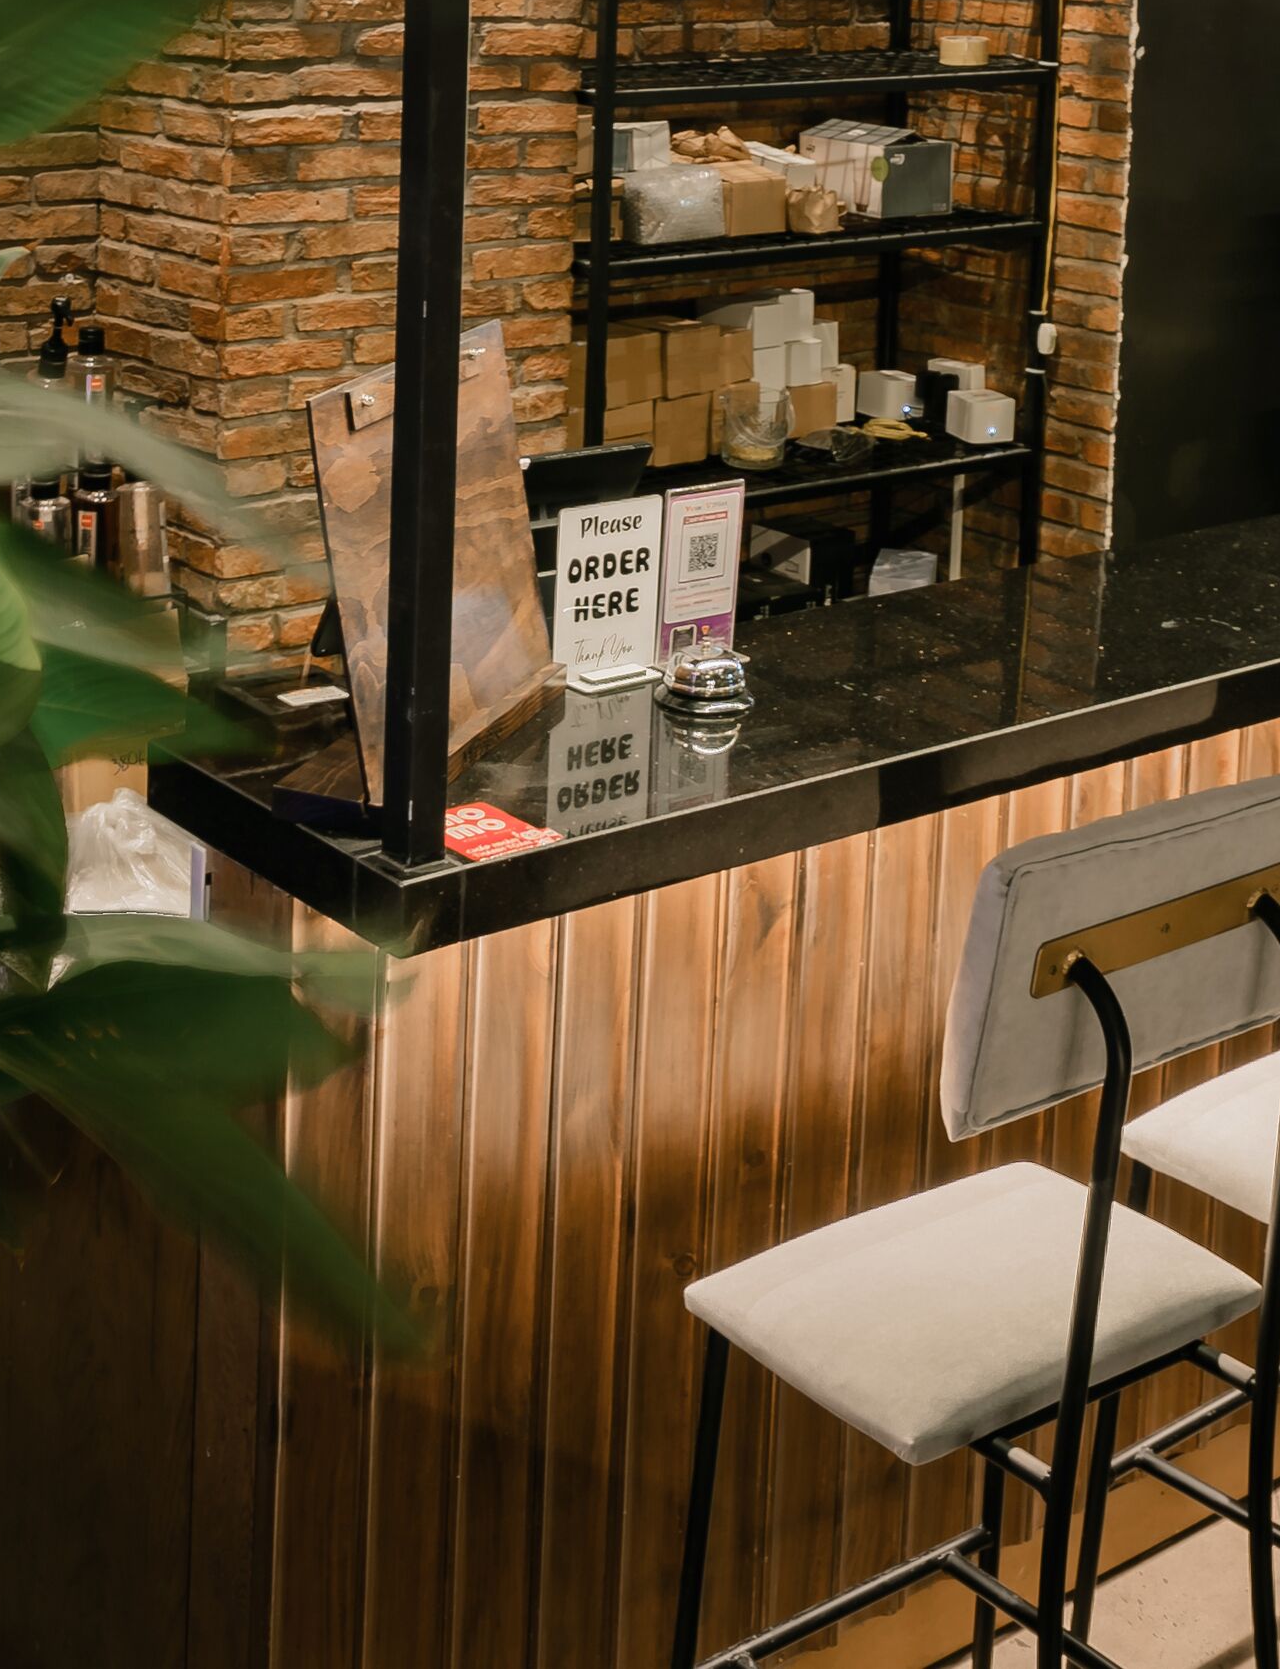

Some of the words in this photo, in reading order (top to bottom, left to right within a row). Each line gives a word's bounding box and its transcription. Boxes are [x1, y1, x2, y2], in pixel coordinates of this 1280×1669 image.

[581, 515, 642, 539] Please
[568, 547, 650, 584] ORDER
[574, 588, 639, 622] HERE
[574, 637, 607, 667] Thank
[605, 633, 634, 662] You
[445, 818, 506, 840] mo
